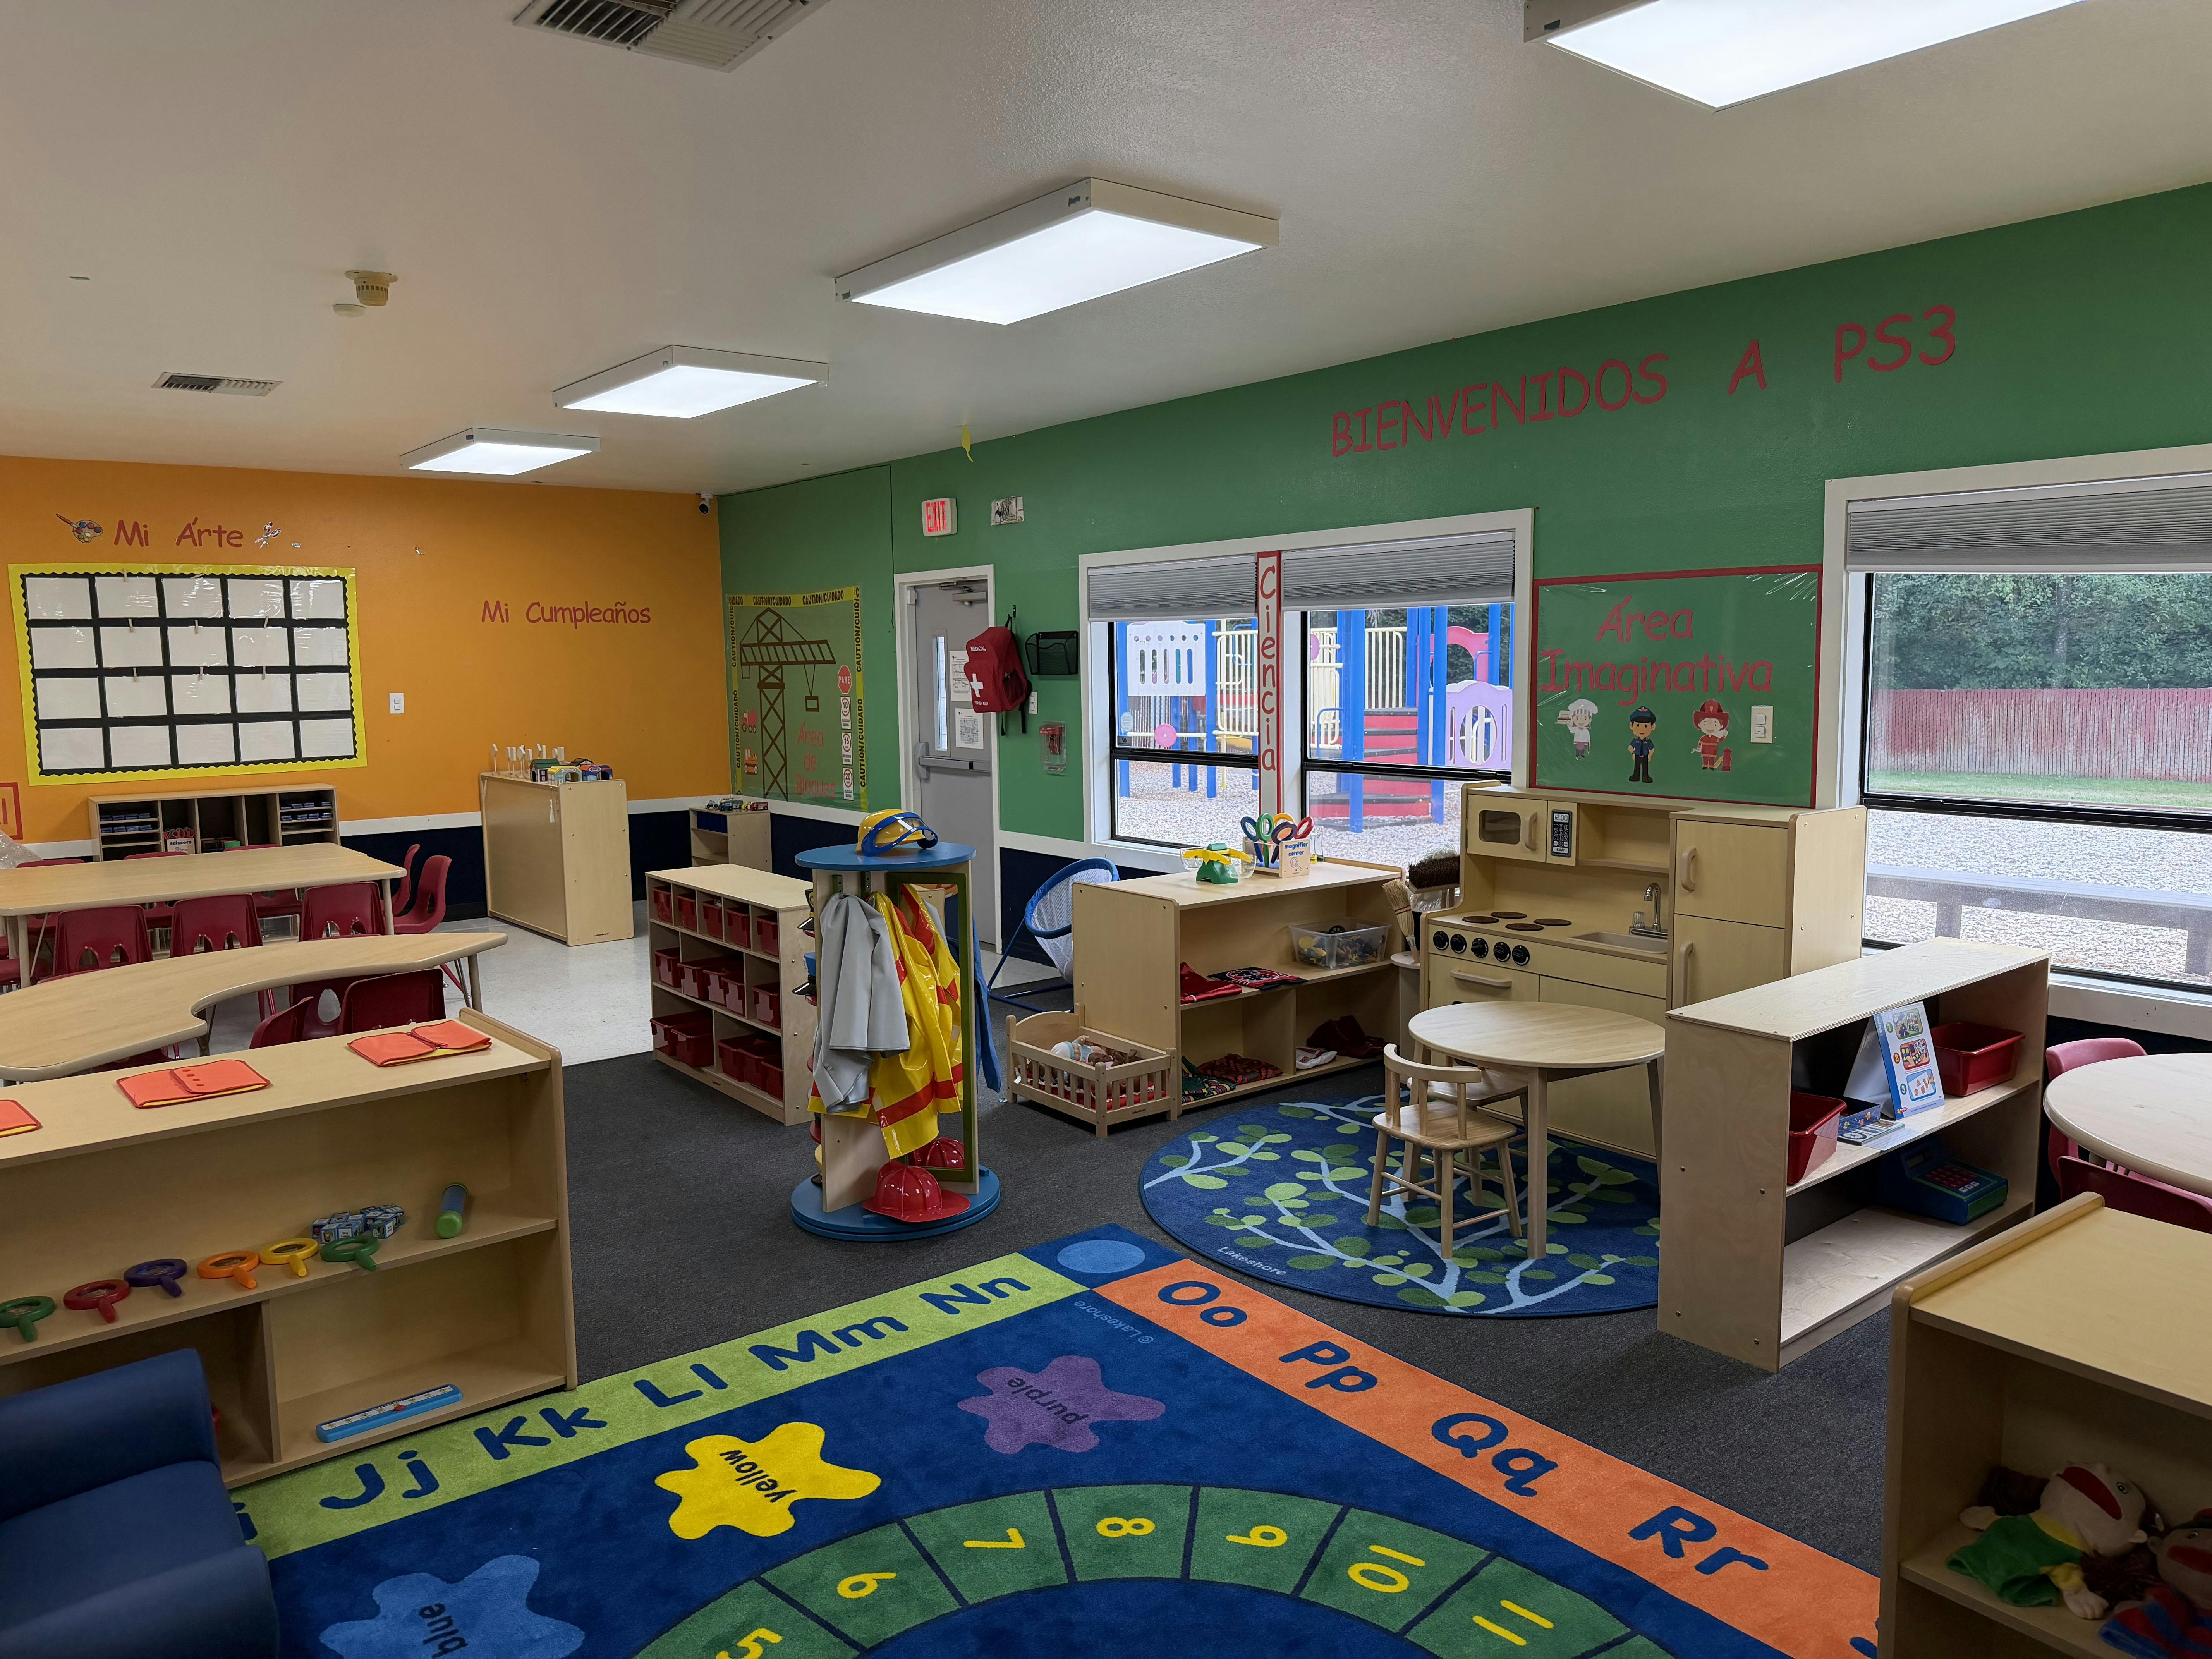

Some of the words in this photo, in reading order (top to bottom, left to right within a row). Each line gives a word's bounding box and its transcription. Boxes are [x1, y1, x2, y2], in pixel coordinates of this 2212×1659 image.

[1332, 354, 1668, 457] BIENVENIDOS
[1729, 340, 1766, 394] A
[1835, 305, 1956, 383] PS3
[114, 520, 149, 547] Mi
[176, 517, 243, 548] Árte
[926, 501, 946, 532] EXIT
[481, 600, 509, 623] Mi
[526, 601, 651, 629] Cumpleaños
[753, 596, 792, 606] CAUTION/CUIDADO
[802, 589, 844, 605] CAUTION/CUIDADO
[1596, 595, 1693, 643] Área
[838, 675, 851, 684] PARE
[1260, 565, 1276, 771] Ciencia
[1540, 649, 1773, 706] Imaginativa
[797, 721, 824, 747] Área
[857, 698, 866, 788] CAUTION/CUIDADO
[804, 749, 817, 771] de
[796, 774, 836, 802] Bloques
[1284, 841, 1308, 850] magnifier
[1217, 1246, 1286, 1275] Lakeshore
[321, 1450, 439, 1510] Jj
[474, 1408, 607, 1460] Kk
[749, 1317, 909, 1371] Mm
[920, 1278, 1031, 1316] Nn
[1007, 1377, 1090, 1424] purple
[1159, 1282, 1247, 1327] Oo
[1280, 1341, 1377, 1393] Pp
[1432, 1414, 1558, 1497] Qq
[1630, 1507, 1768, 1575] Rr
[719, 1450, 798, 1503] yellow
[838, 1572, 896, 1599] 6
[964, 1528, 1025, 1549] 7
[1097, 1517, 1155, 1537] 8
[1227, 1525, 1288, 1547] 9
[1348, 1545, 1425, 1593] 10
[1473, 1600, 1553, 1645] 11
[418, 1603, 469, 1659] blue
